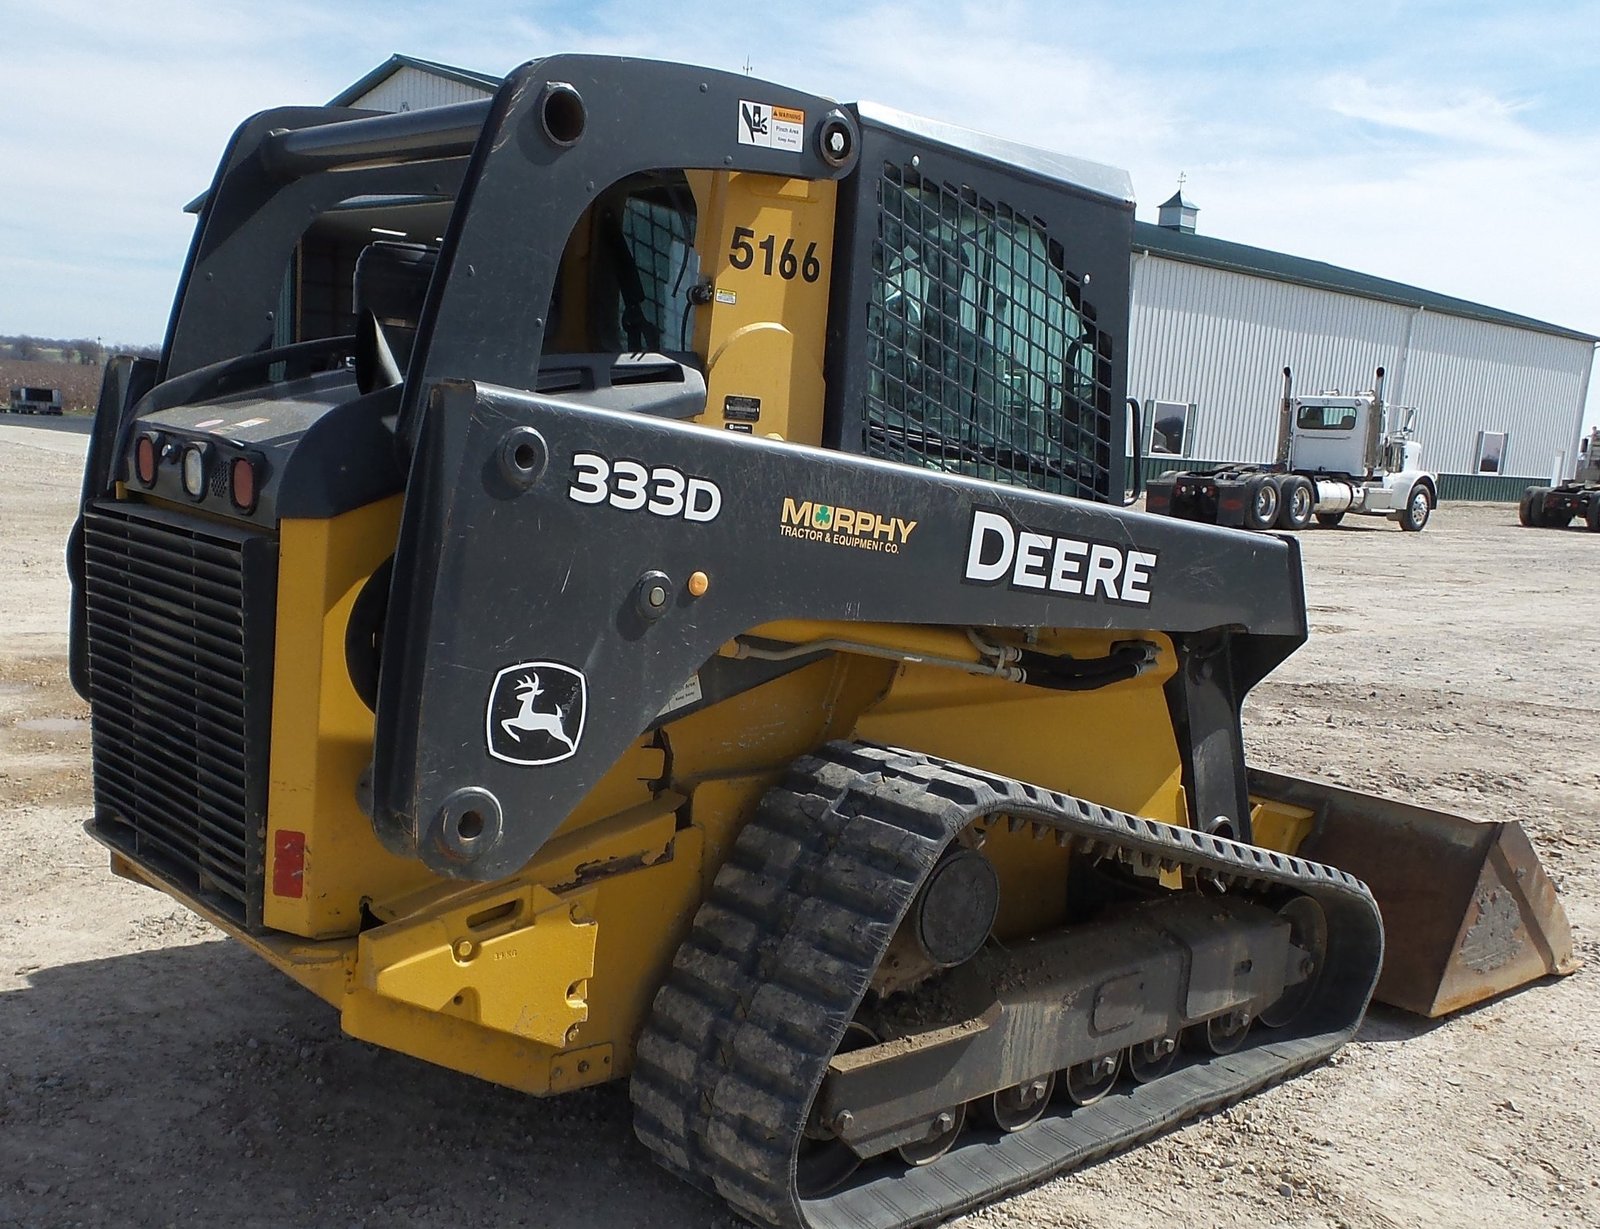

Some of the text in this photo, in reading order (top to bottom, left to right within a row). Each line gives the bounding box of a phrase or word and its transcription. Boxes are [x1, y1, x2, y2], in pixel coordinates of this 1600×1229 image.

[775, 125, 788, 133] Pinch
[778, 111, 802, 121] WARNING
[728, 226, 820, 283] 5166
[569, 453, 722, 523] 333D
[780, 525, 900, 554] TRACTOR & EQUIPMENT CO.
[781, 497, 918, 544] MURPHY
[965, 510, 1158, 604] DEERE
